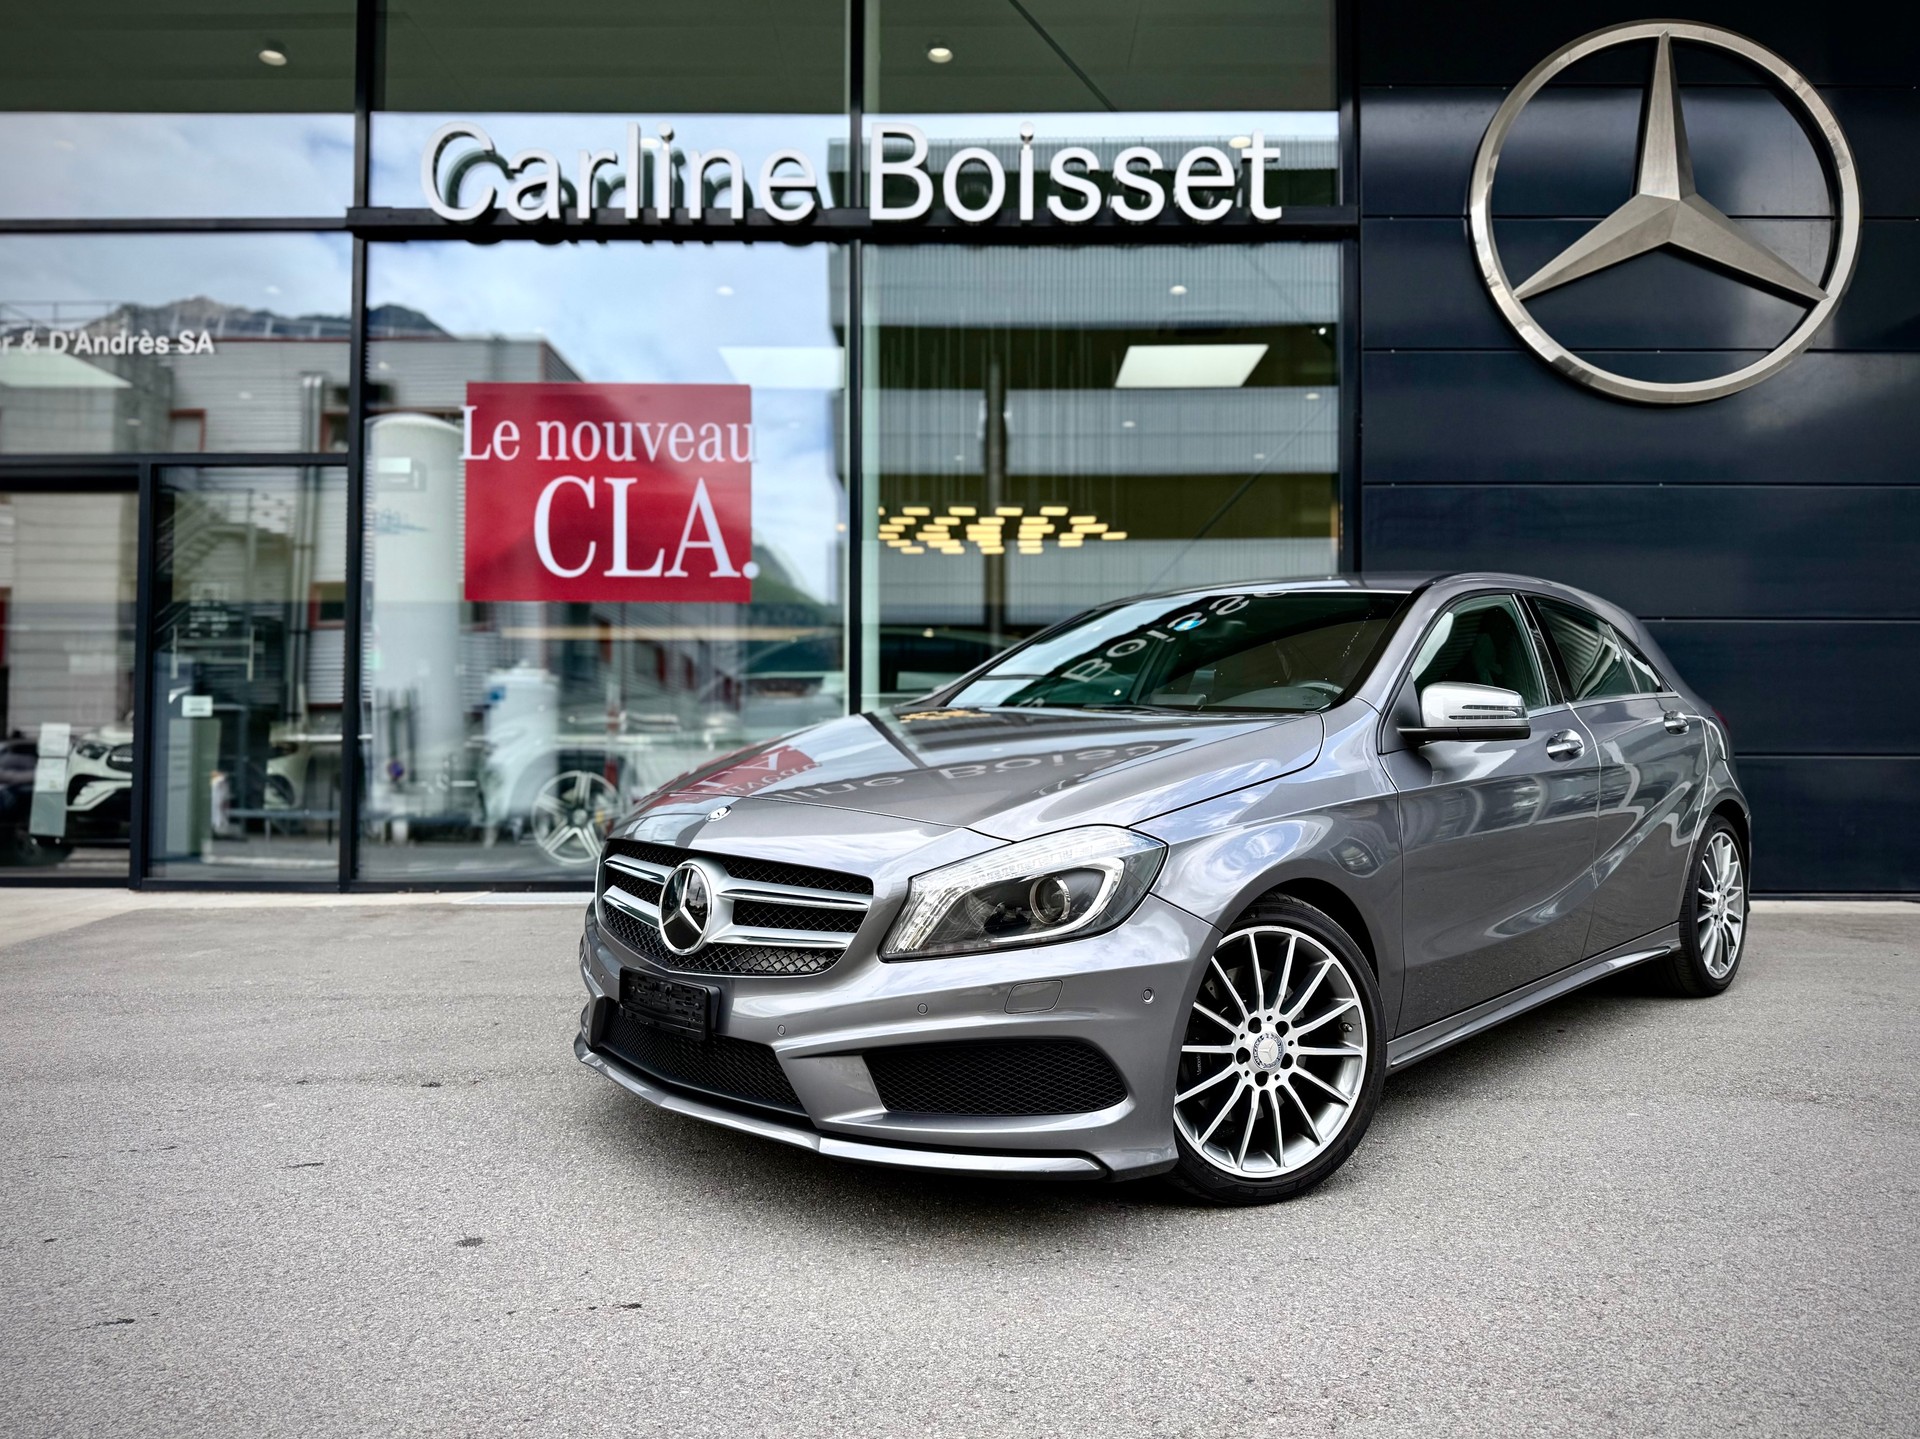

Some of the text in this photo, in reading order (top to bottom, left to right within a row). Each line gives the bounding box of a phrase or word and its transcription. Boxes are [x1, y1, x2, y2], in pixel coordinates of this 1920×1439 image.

[420, 121, 1282, 222] Carline Boisset
[20, 331, 39, 354] &
[50, 329, 169, 355] D'Andrès
[178, 330, 214, 354] SA
[459, 405, 758, 463] Le nouveau
[534, 475, 760, 579] CLA.
